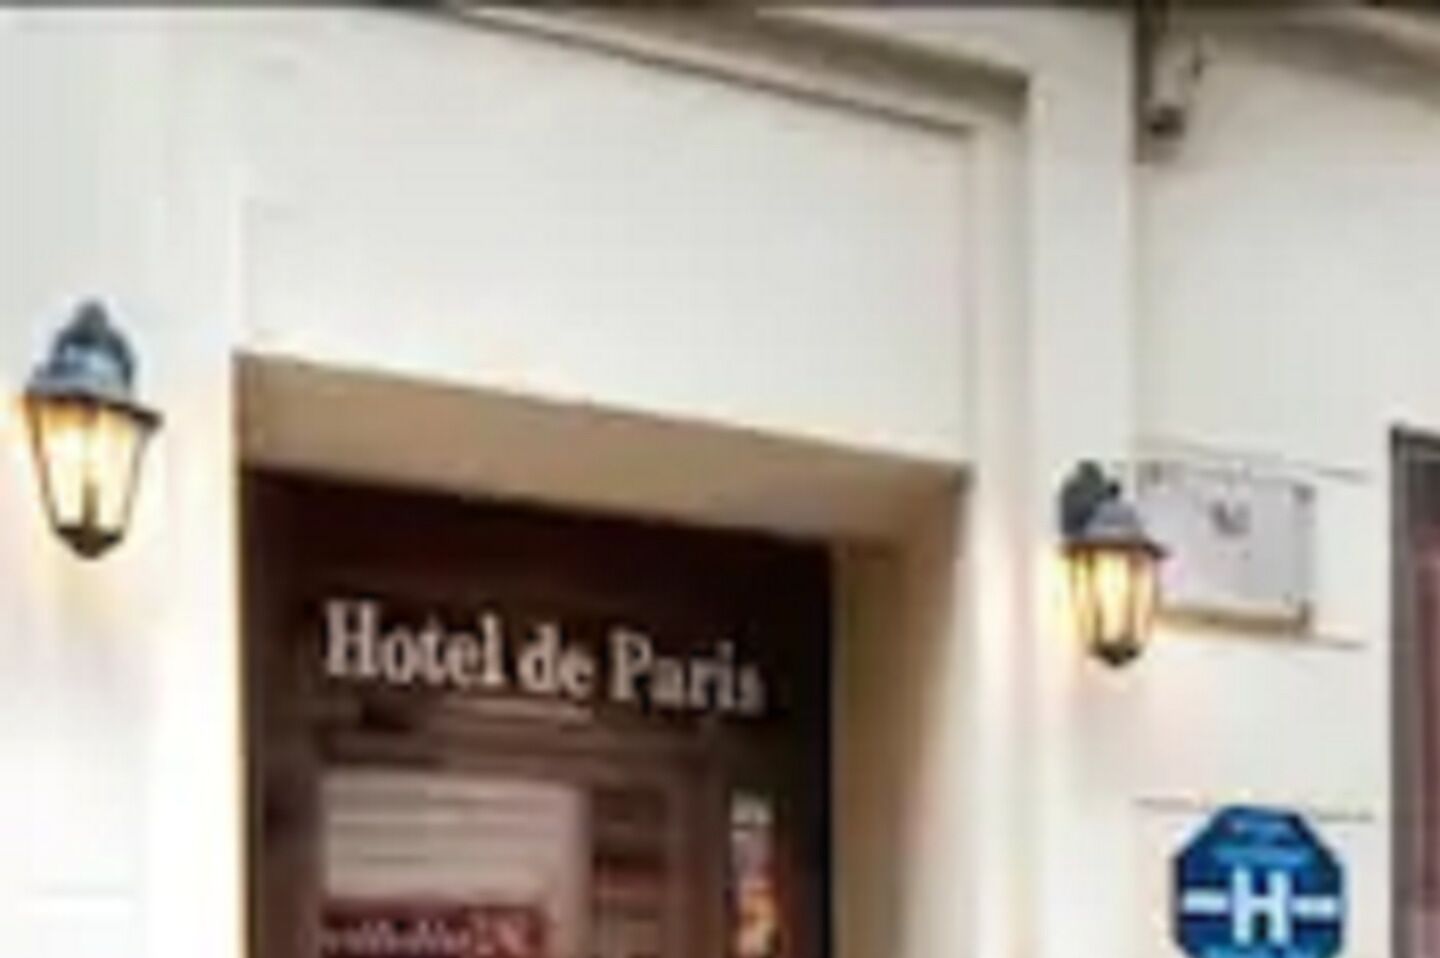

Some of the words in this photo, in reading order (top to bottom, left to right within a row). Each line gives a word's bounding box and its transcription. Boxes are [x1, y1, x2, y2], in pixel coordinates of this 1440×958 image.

[325, 600, 505, 686] Hotel
[518, 623, 596, 697] de
[609, 627, 766, 715] Paris
[1231, 866, 1292, 945] H
